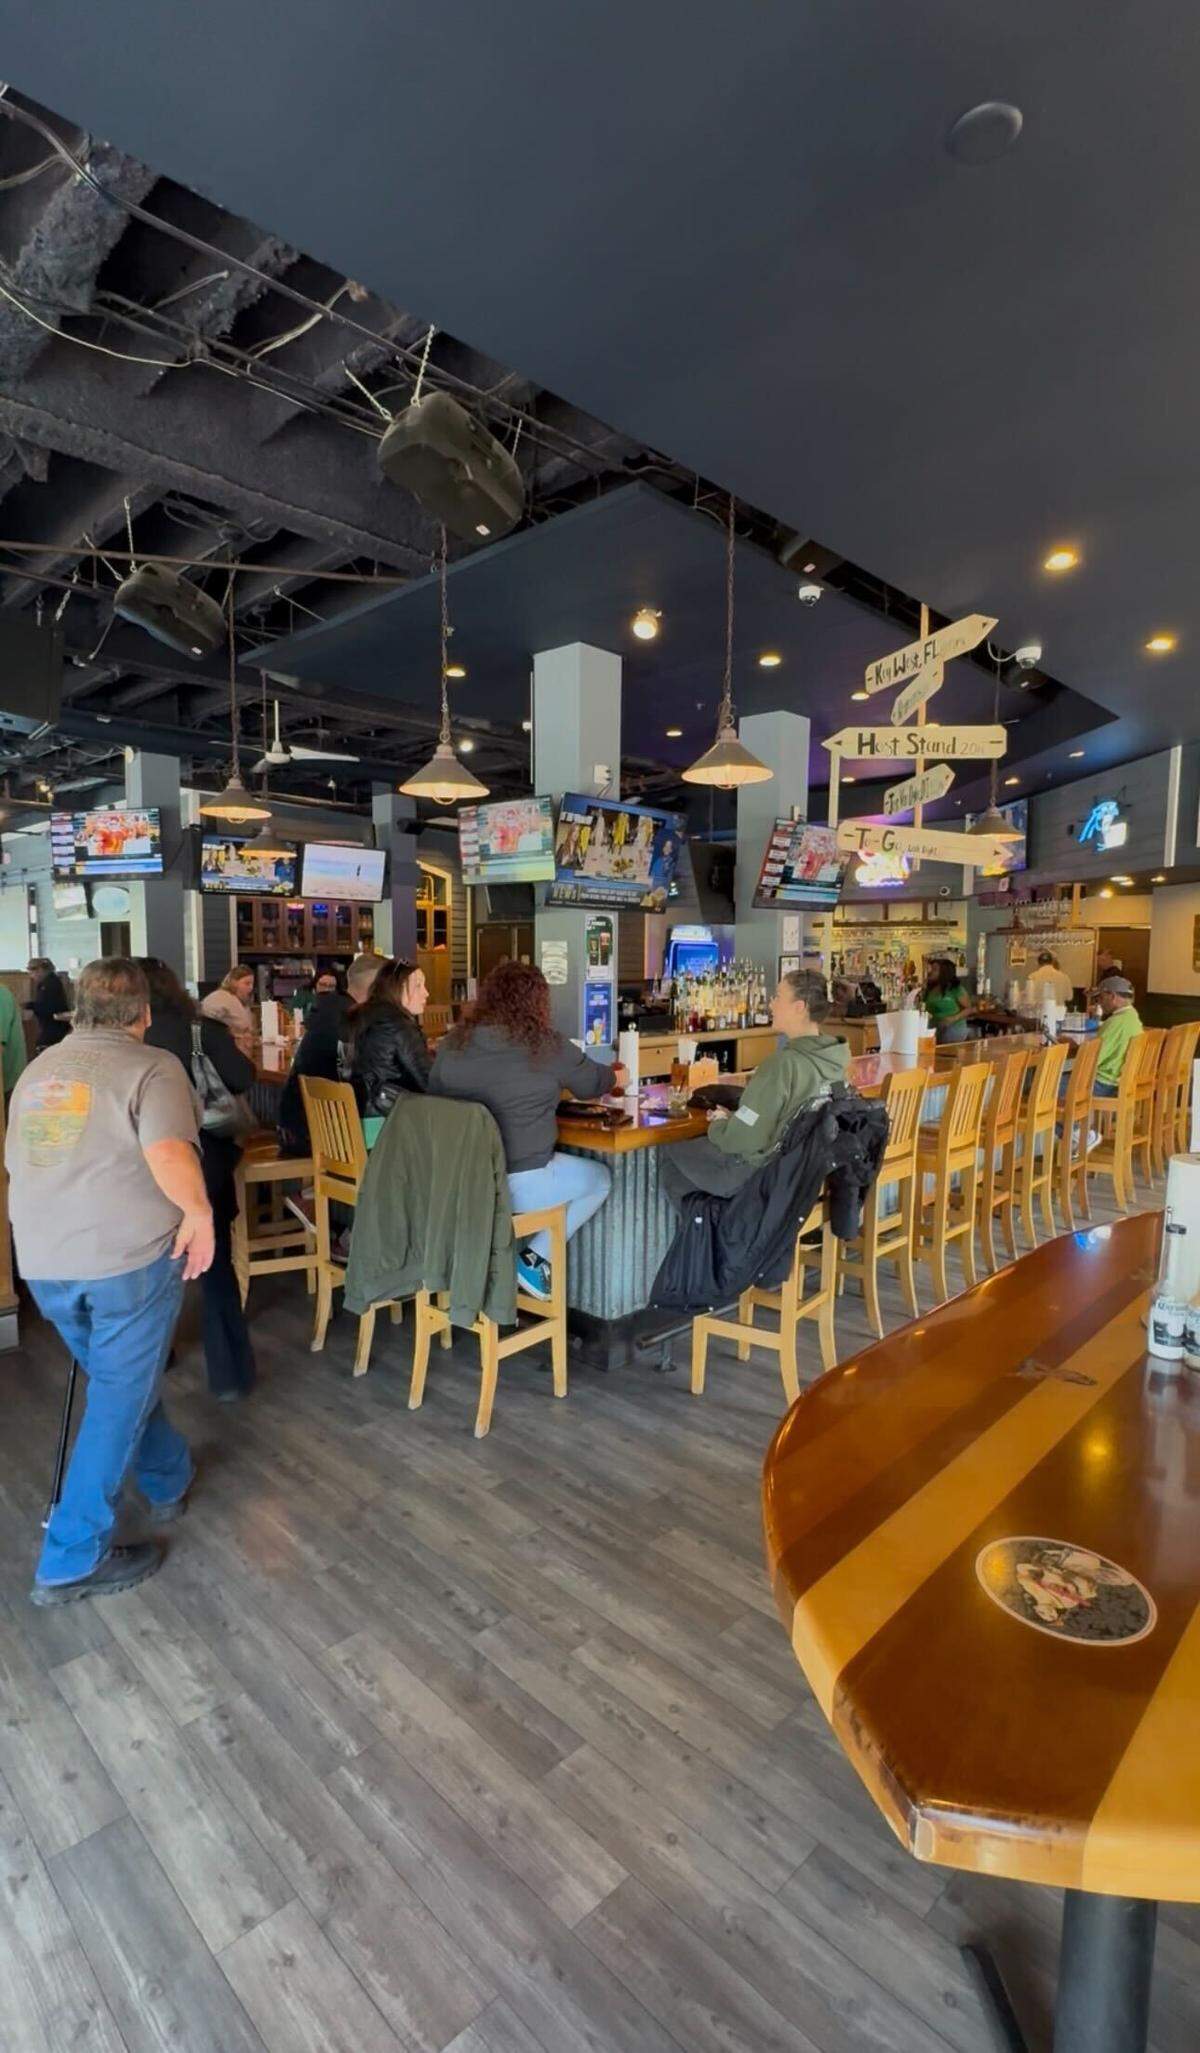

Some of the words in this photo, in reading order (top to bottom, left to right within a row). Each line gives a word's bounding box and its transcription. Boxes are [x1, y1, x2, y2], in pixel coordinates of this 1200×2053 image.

[923, 639, 939, 664] FL
[857, 732, 900, 756] Host
[906, 732, 956, 755] Stand
[854, 827, 901, 852] To-Go
